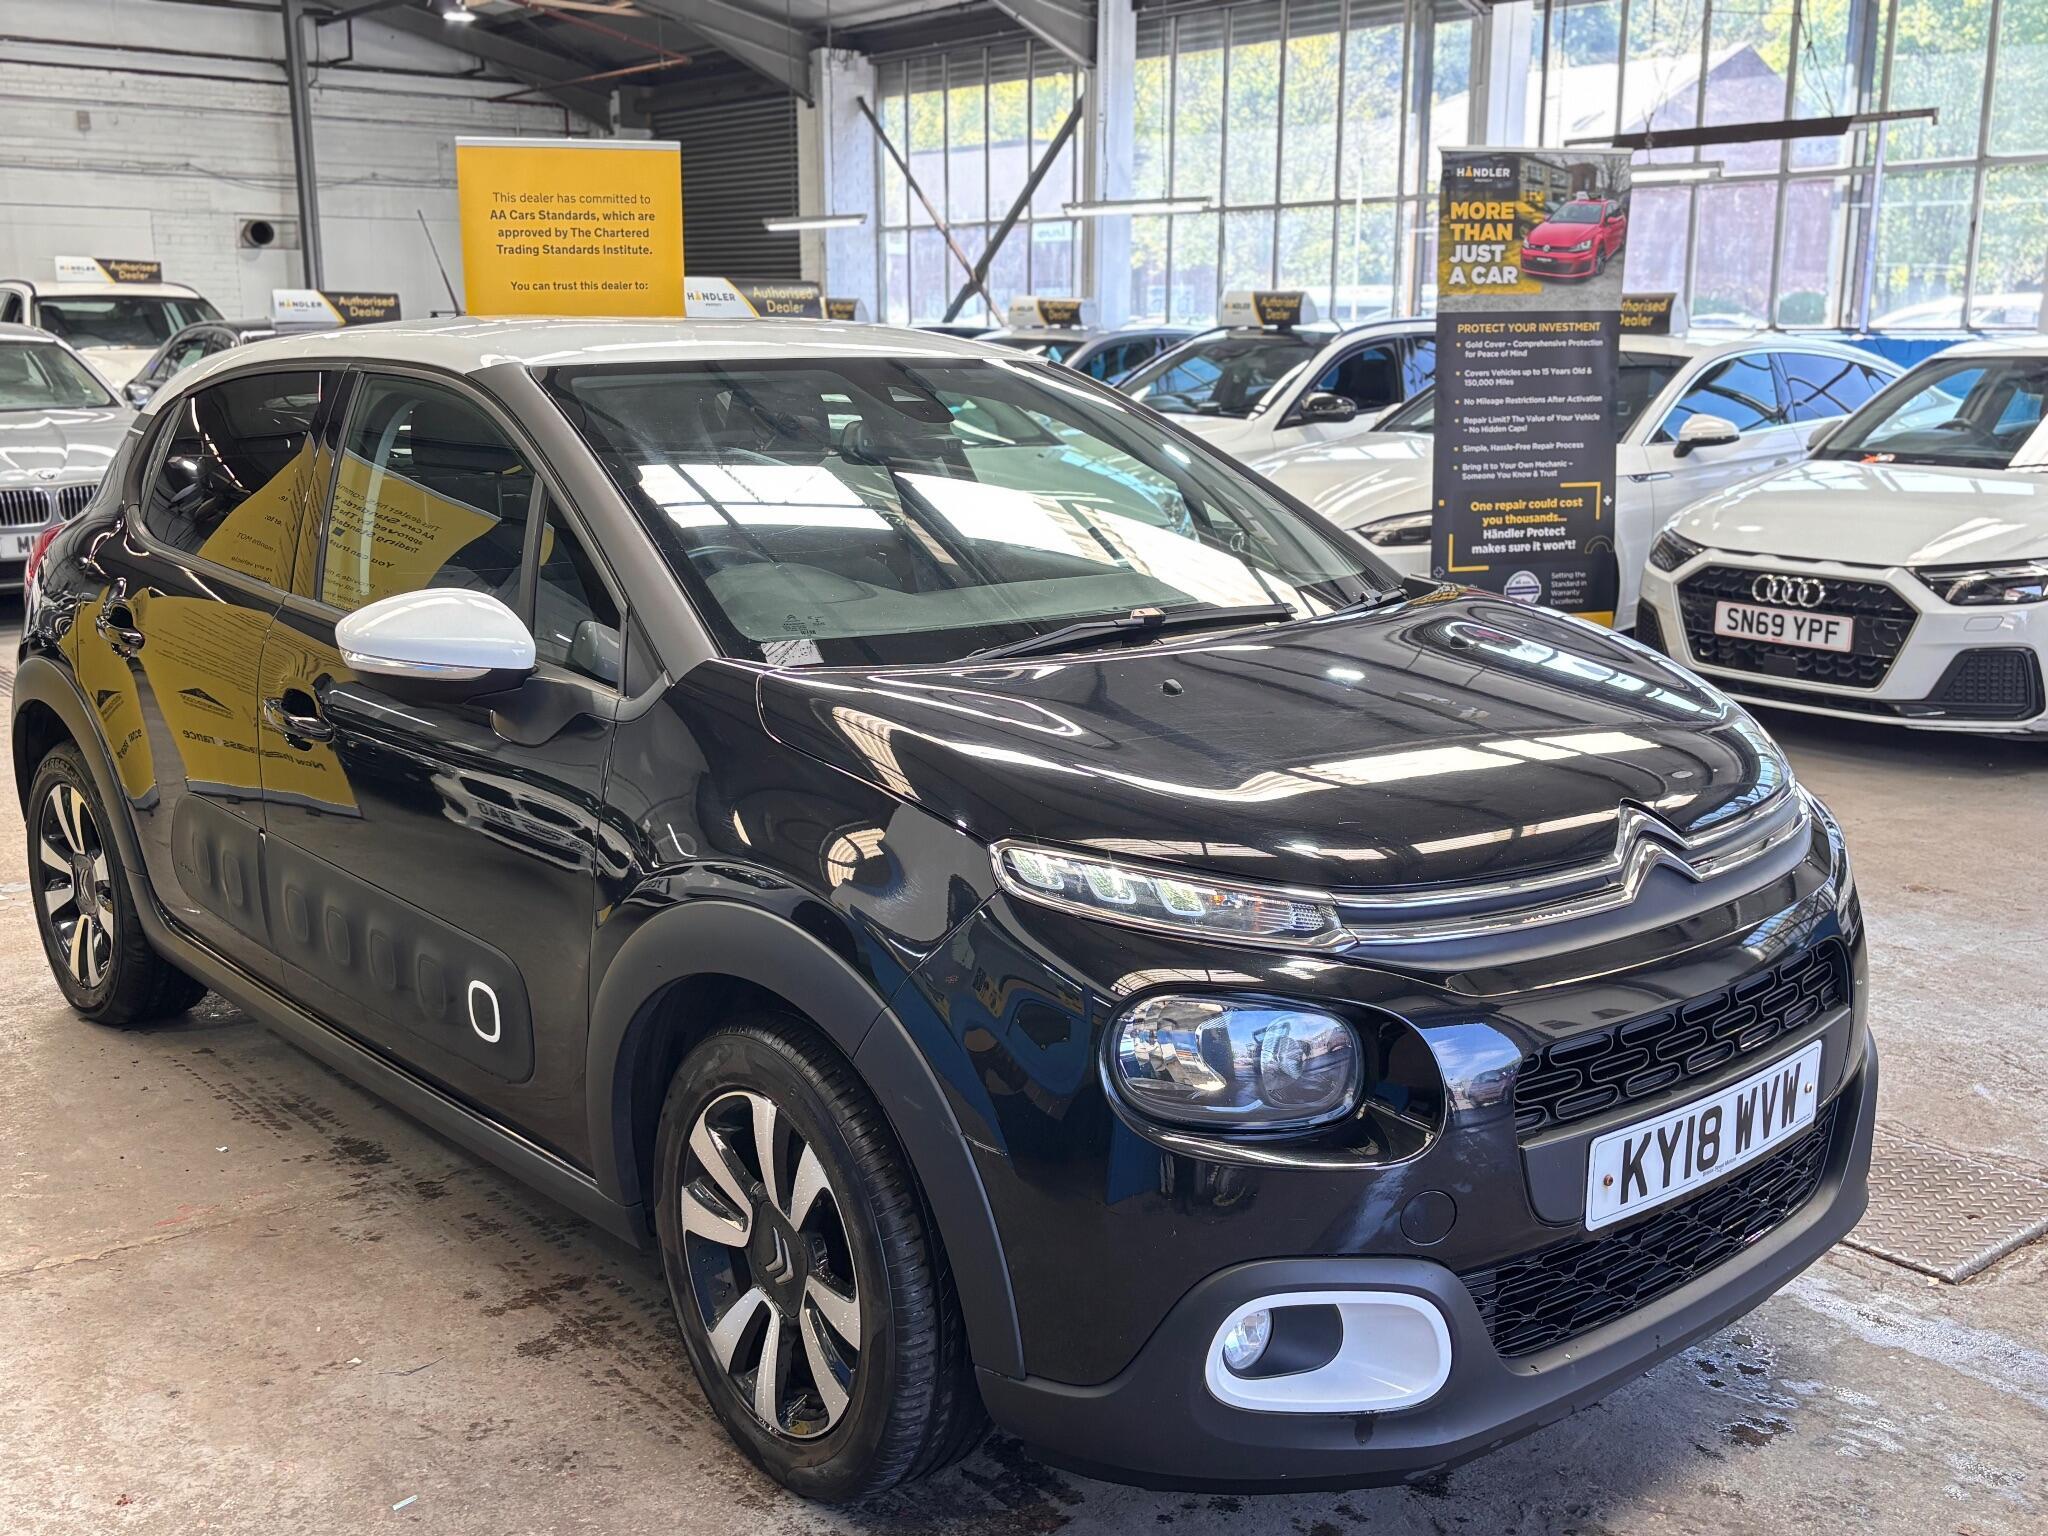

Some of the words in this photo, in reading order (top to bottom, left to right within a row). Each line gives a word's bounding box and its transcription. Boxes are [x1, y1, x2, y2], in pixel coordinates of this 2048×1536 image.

[493, 192, 517, 203] This
[519, 192, 554, 203] dealer
[557, 193, 576, 203] has
[579, 193, 637, 204] committed
[640, 194, 651, 204] to
[490, 210, 507, 220] AA
[509, 210, 536, 221] Cars
[538, 210, 600, 222] Standards,
[602, 211, 635, 222] which
[638, 212, 655, 222] are
[1450, 202, 1516, 220] MORE
[498, 228, 552, 239] approved
[555, 228, 568, 239] by
[570, 228, 592, 238] The
[594, 228, 650, 238] Chartered
[1450, 223, 1513, 241] THAN
[496, 244, 540, 256] Trading
[542, 244, 600, 255] Standards
[603, 244, 653, 255] Institute.
[1449, 244, 1506, 263] JUST
[1449, 266, 1468, 285] A
[1471, 266, 1518, 285] CAR
[510, 281, 530, 291] You
[532, 282, 551, 291] can
[553, 281, 577, 290] trust
[580, 281, 599, 290] this
[601, 281, 632, 290] dealer
[635, 281, 648, 290] to:
[753, 286, 818, 299] Authorised
[339, 295, 396, 307] Authorised
[766, 299, 805, 313] Dealer
[349, 306, 386, 317] Dealer
[1457, 323, 1506, 334] PROTECT
[1507, 323, 1537, 333] YOUR
[1538, 322, 1602, 333] INVESTMENT
[1465, 340, 1483, 349] Gold
[1485, 340, 1506, 349] Cover
[1513, 339, 1567, 349] Comprehensive
[1568, 339, 1604, 347] Protection
[1465, 350, 1476, 358] for
[1477, 350, 1499, 358] Peace
[1510, 349, 1528, 357] Mind
[1464, 369, 1490, 378] Covers
[1491, 368, 1521, 377] Vehicles
[1522, 369, 1532, 377] up
[1572, 367, 1586, 375] Old
[1464, 378, 1495, 387] 150,000
[1496, 378, 1514, 386] Miles
[1464, 398, 1475, 406] No
[1476, 397, 1504, 406] Mileage
[1505, 396, 1546, 405] Restrictions
[1567, 395, 1603, 403] Activation
[1464, 416, 1487, 425] Repair
[1488, 415, 1511, 424] Limit?
[1512, 415, 1525, 423] The
[1526, 414, 1546, 423] Value
[1547, 414, 1555, 422] of
[1556, 414, 1574, 422] Your
[1575, 413, 1600, 421] Vehicle
[1469, 426, 1480, 434] No
[1481, 425, 1507, 433] Hidden
[1508, 424, 1528, 433] Caps!
[1463, 444, 1490, 453] Simple,
[1490, 443, 1531, 452] Hassle-Free
[1532, 442, 1555, 451] Repair
[1556, 441, 1584, 449] Process
[1462, 463, 1482, 472] Bring
[1499, 462, 1517, 470] Your
[1518, 461, 1534, 469] Own
[1535, 460, 1567, 469] Mechanic
[1462, 472, 1496, 480] Someone
[1496, 472, 1511, 480] You
[1512, 471, 1532, 479] Know
[1539, 470, 1558, 478] Trust
[1470, 501, 1493, 512] One
[1495, 500, 1527, 512] repair
[1528, 498, 1558, 510] could
[1559, 498, 1583, 509] cost
[1482, 516, 1503, 527] you
[1505, 512, 1568, 524] thousands...
[1527, 526, 1566, 538] Protect
[1471, 543, 1507, 555] makes
[1508, 543, 1531, 553] sure
[1532, 541, 1541, 552] it
[1542, 540, 1577, 551] won't!
[1551, 571, 1573, 581] Setting
[1574, 571, 1587, 579] the
[1551, 579, 1581, 588] Standard
[1582, 579, 1587, 587] in
[1551, 588, 1580, 598] Warranty
[1550, 597, 1584, 605] Excellence
[1726, 607, 1785, 637] SN69
[1793, 615, 1840, 644] YPF
[1620, 1105, 1723, 1205] KY18
[1735, 1061, 1802, 1156] WVW
